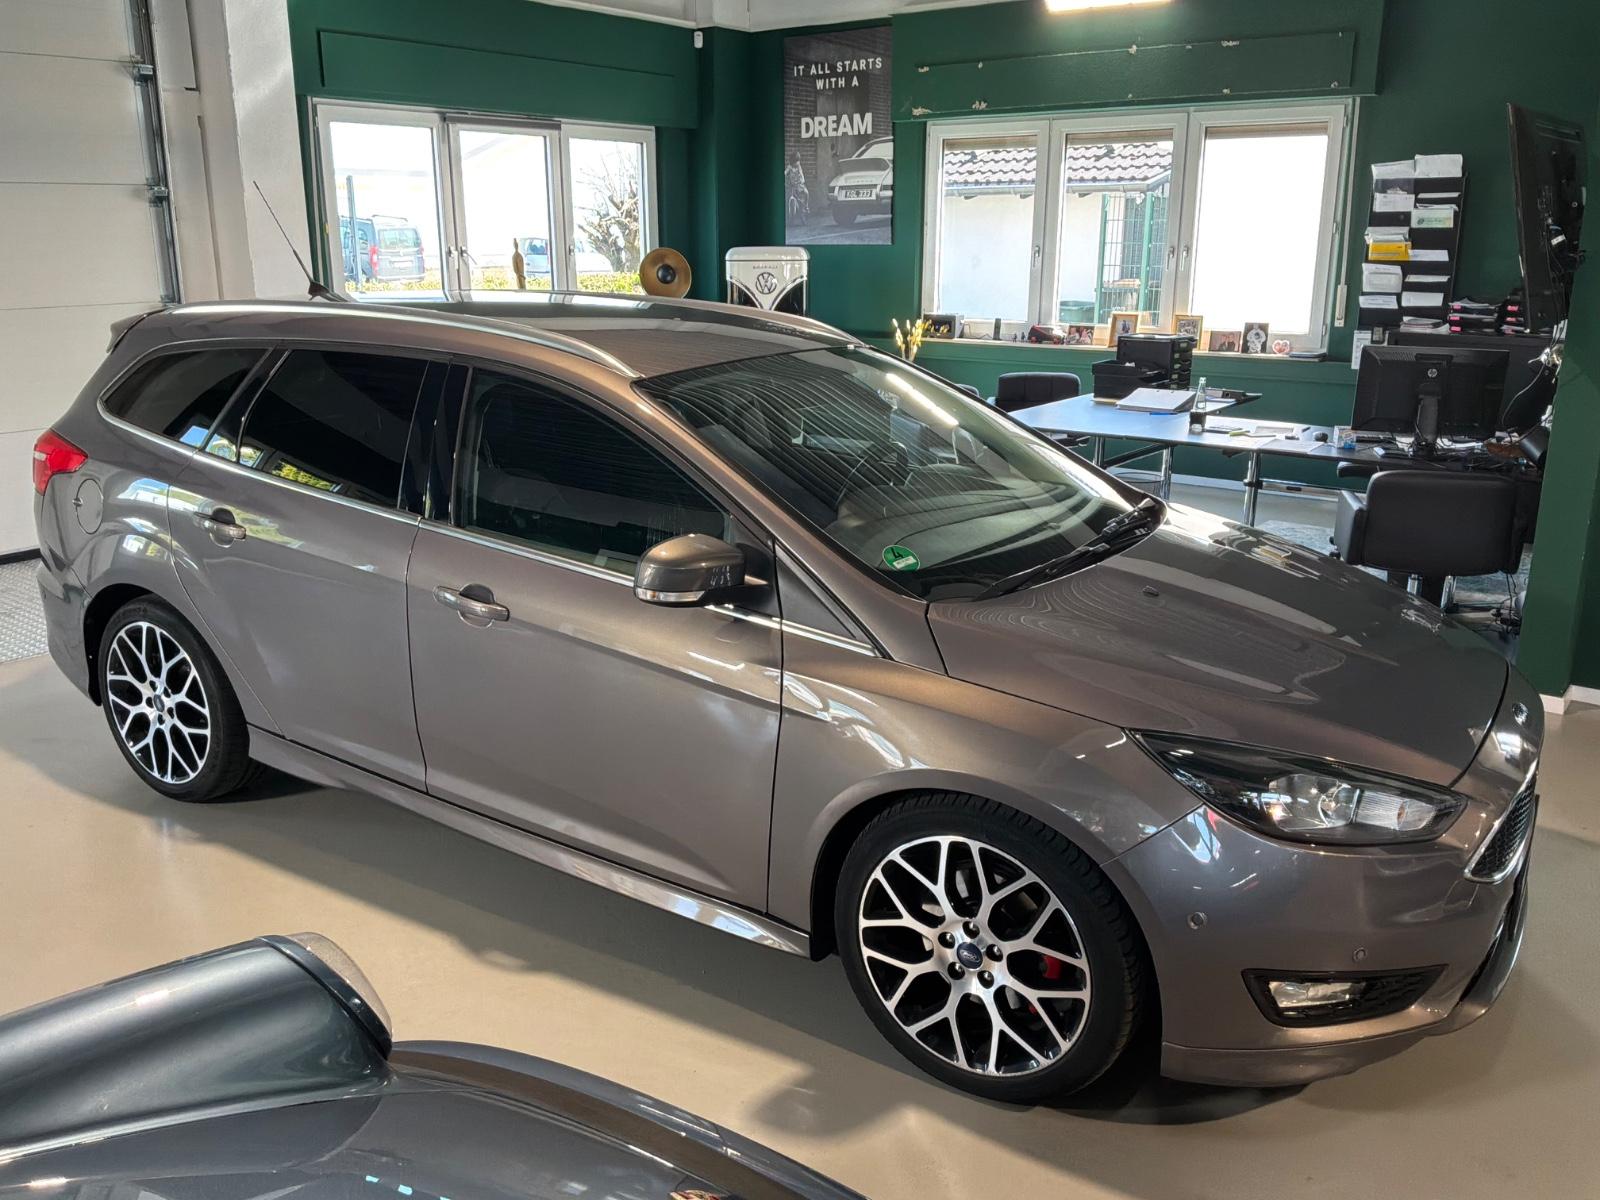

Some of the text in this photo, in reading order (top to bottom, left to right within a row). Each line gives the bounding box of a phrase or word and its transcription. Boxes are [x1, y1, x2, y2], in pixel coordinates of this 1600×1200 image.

[794, 57, 882, 77] IT ALL STARTS
[816, 75, 859, 90] WITH A
[801, 112, 873, 139] DREAM
[890, 547, 904, 558] 4
